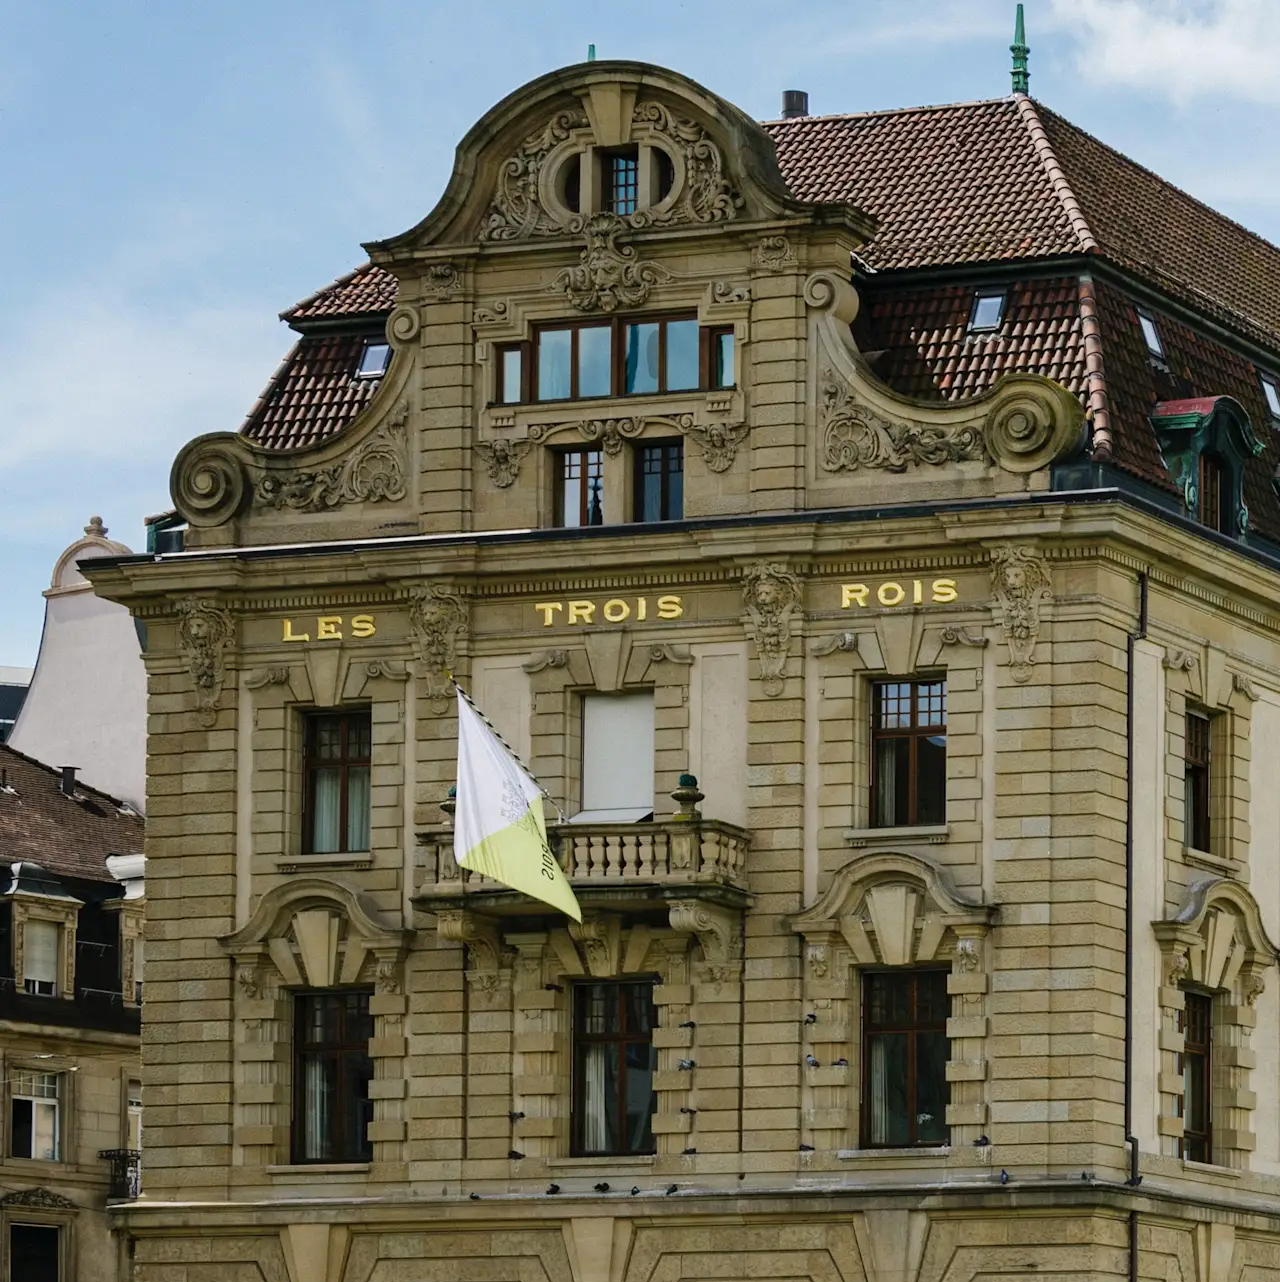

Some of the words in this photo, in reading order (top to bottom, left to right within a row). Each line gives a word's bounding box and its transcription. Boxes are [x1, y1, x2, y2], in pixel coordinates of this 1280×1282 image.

[282, 614, 376, 642] LES
[535, 595, 683, 627] TROIS
[841, 578, 958, 608] ROIS
